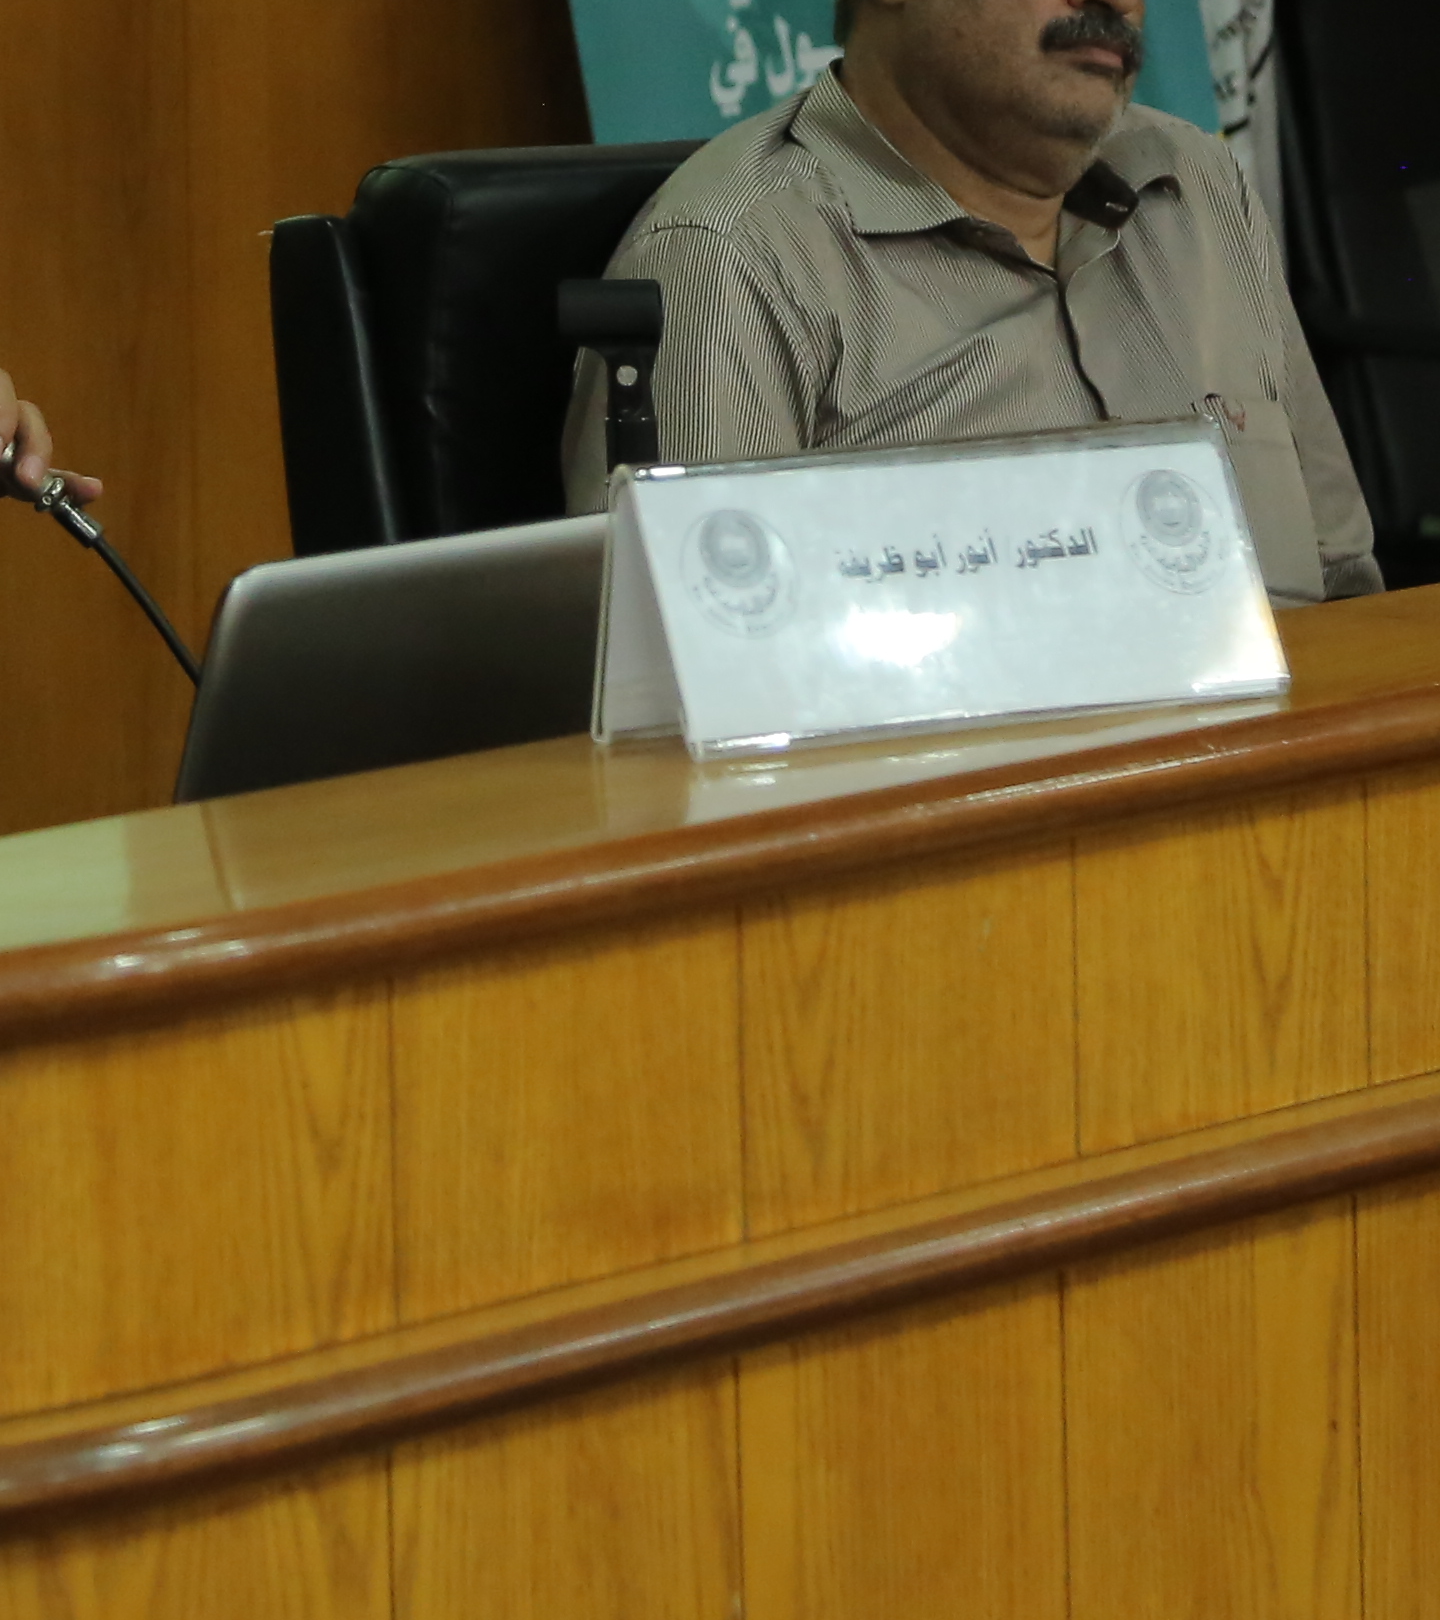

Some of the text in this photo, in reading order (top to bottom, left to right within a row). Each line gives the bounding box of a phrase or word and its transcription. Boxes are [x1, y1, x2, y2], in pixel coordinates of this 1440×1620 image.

[710, 16, 760, 118] في
[914, 533, 947, 578] أبو
[956, 528, 998, 575] أنور
[1015, 526, 1098, 569] الدكتور
